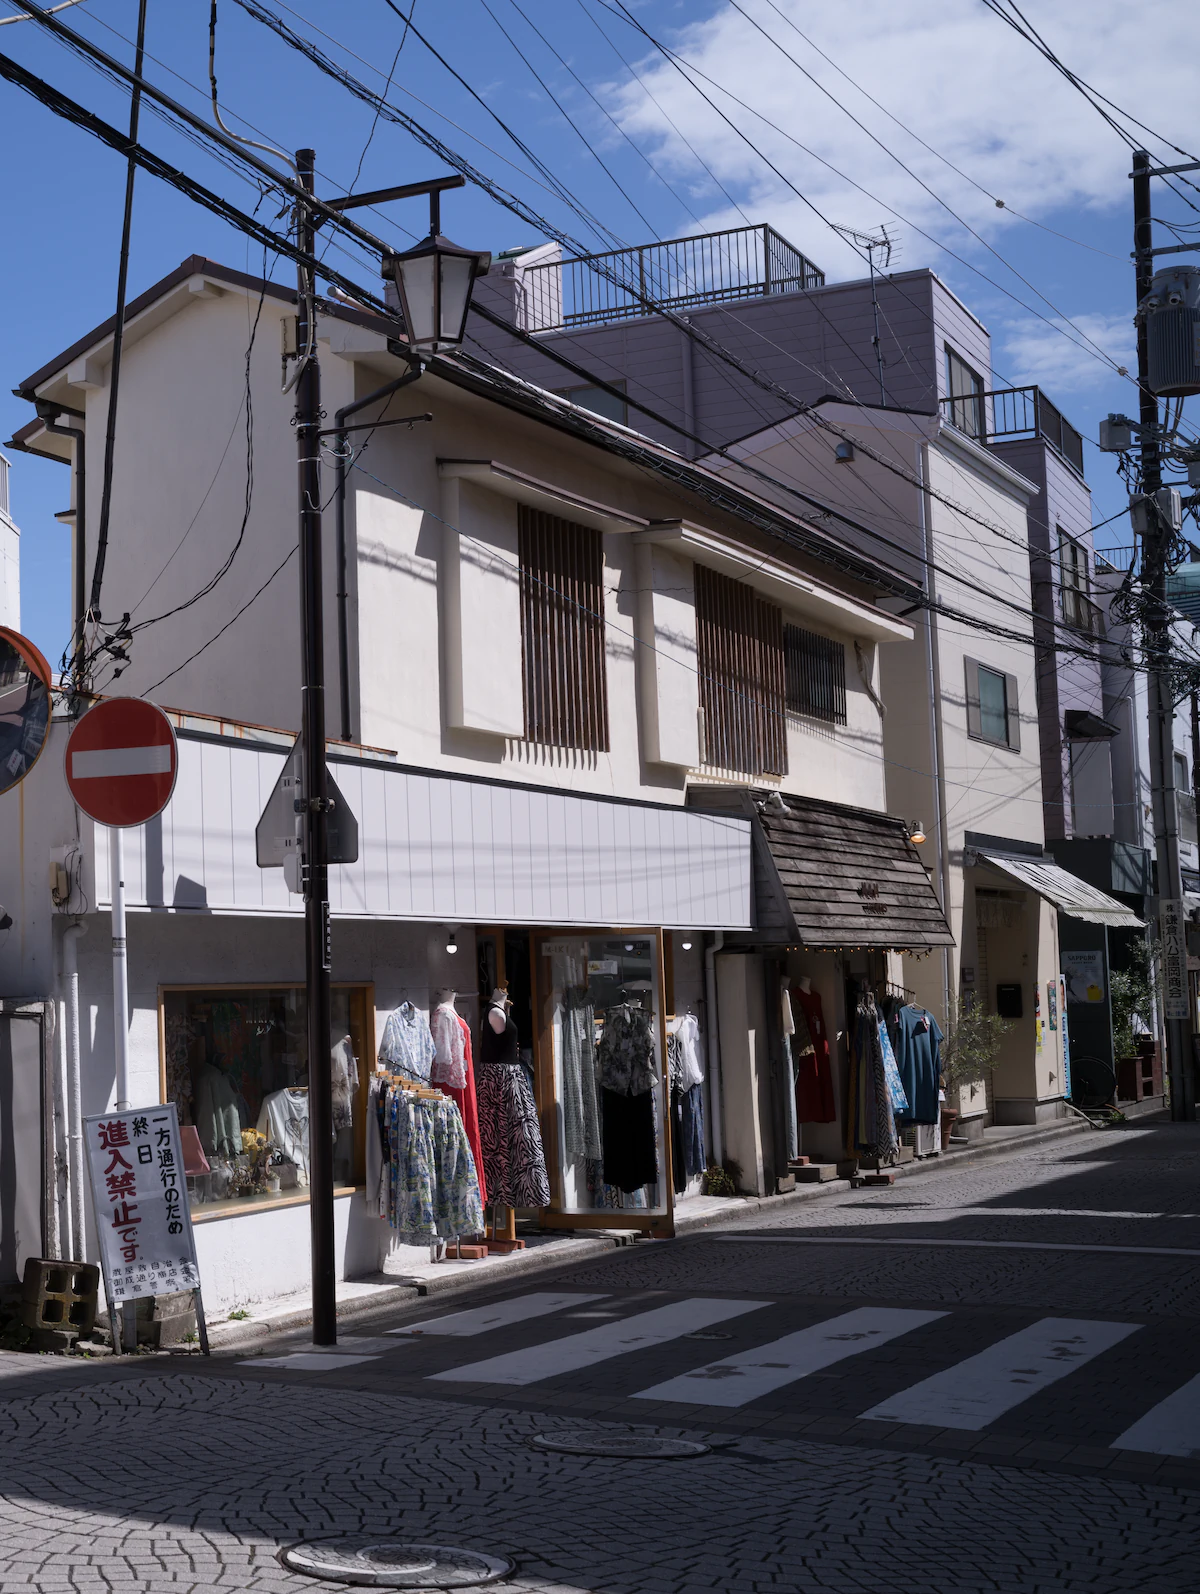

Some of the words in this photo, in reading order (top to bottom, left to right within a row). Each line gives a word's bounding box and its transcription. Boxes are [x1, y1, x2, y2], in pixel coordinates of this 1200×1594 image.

[97, 1119, 144, 1263] 進入禁止です。
[131, 1116, 153, 1165] 終日
[152, 1116, 184, 1235] 一方通行のため
